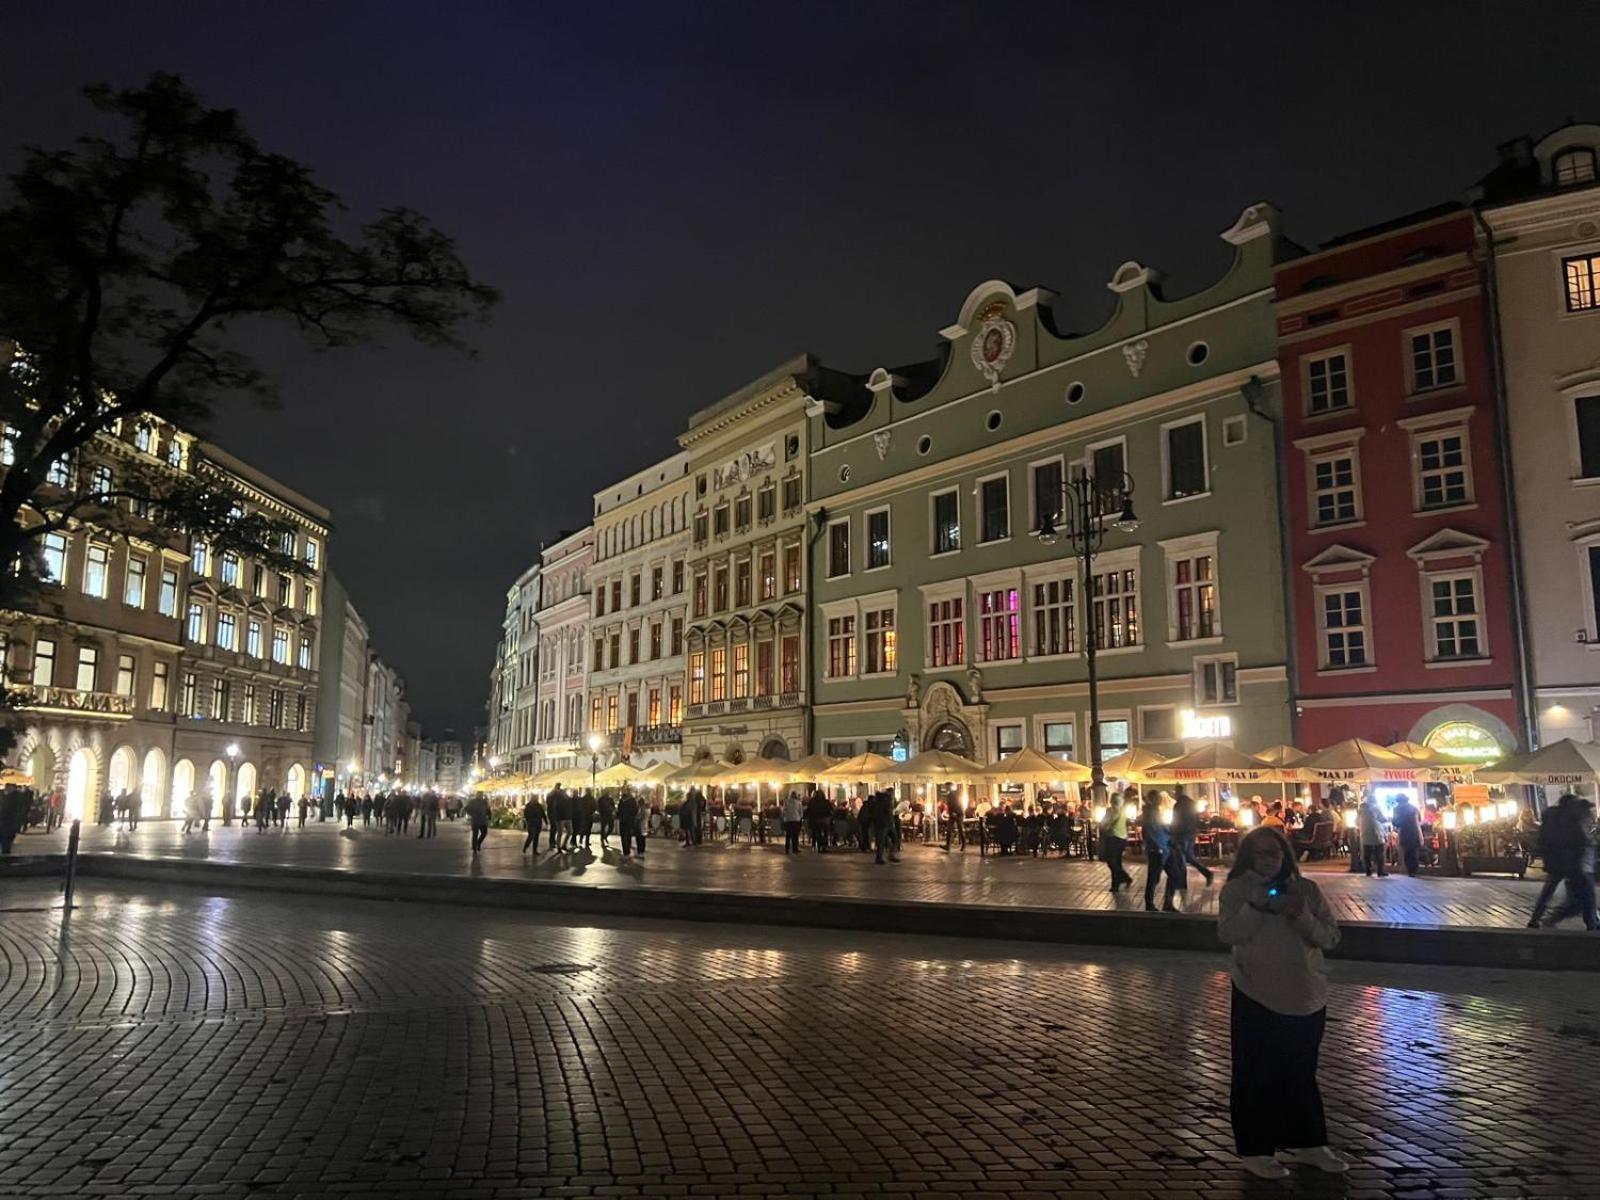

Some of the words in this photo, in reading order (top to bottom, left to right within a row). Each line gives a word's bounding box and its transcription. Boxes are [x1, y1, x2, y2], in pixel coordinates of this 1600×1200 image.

[1226, 771, 1246, 779] MAX
[1248, 771, 1259, 779] 18
[1318, 771, 1341, 779] MAX
[1344, 771, 1354, 779] 18
[1548, 775, 1582, 784] OKOCIM
